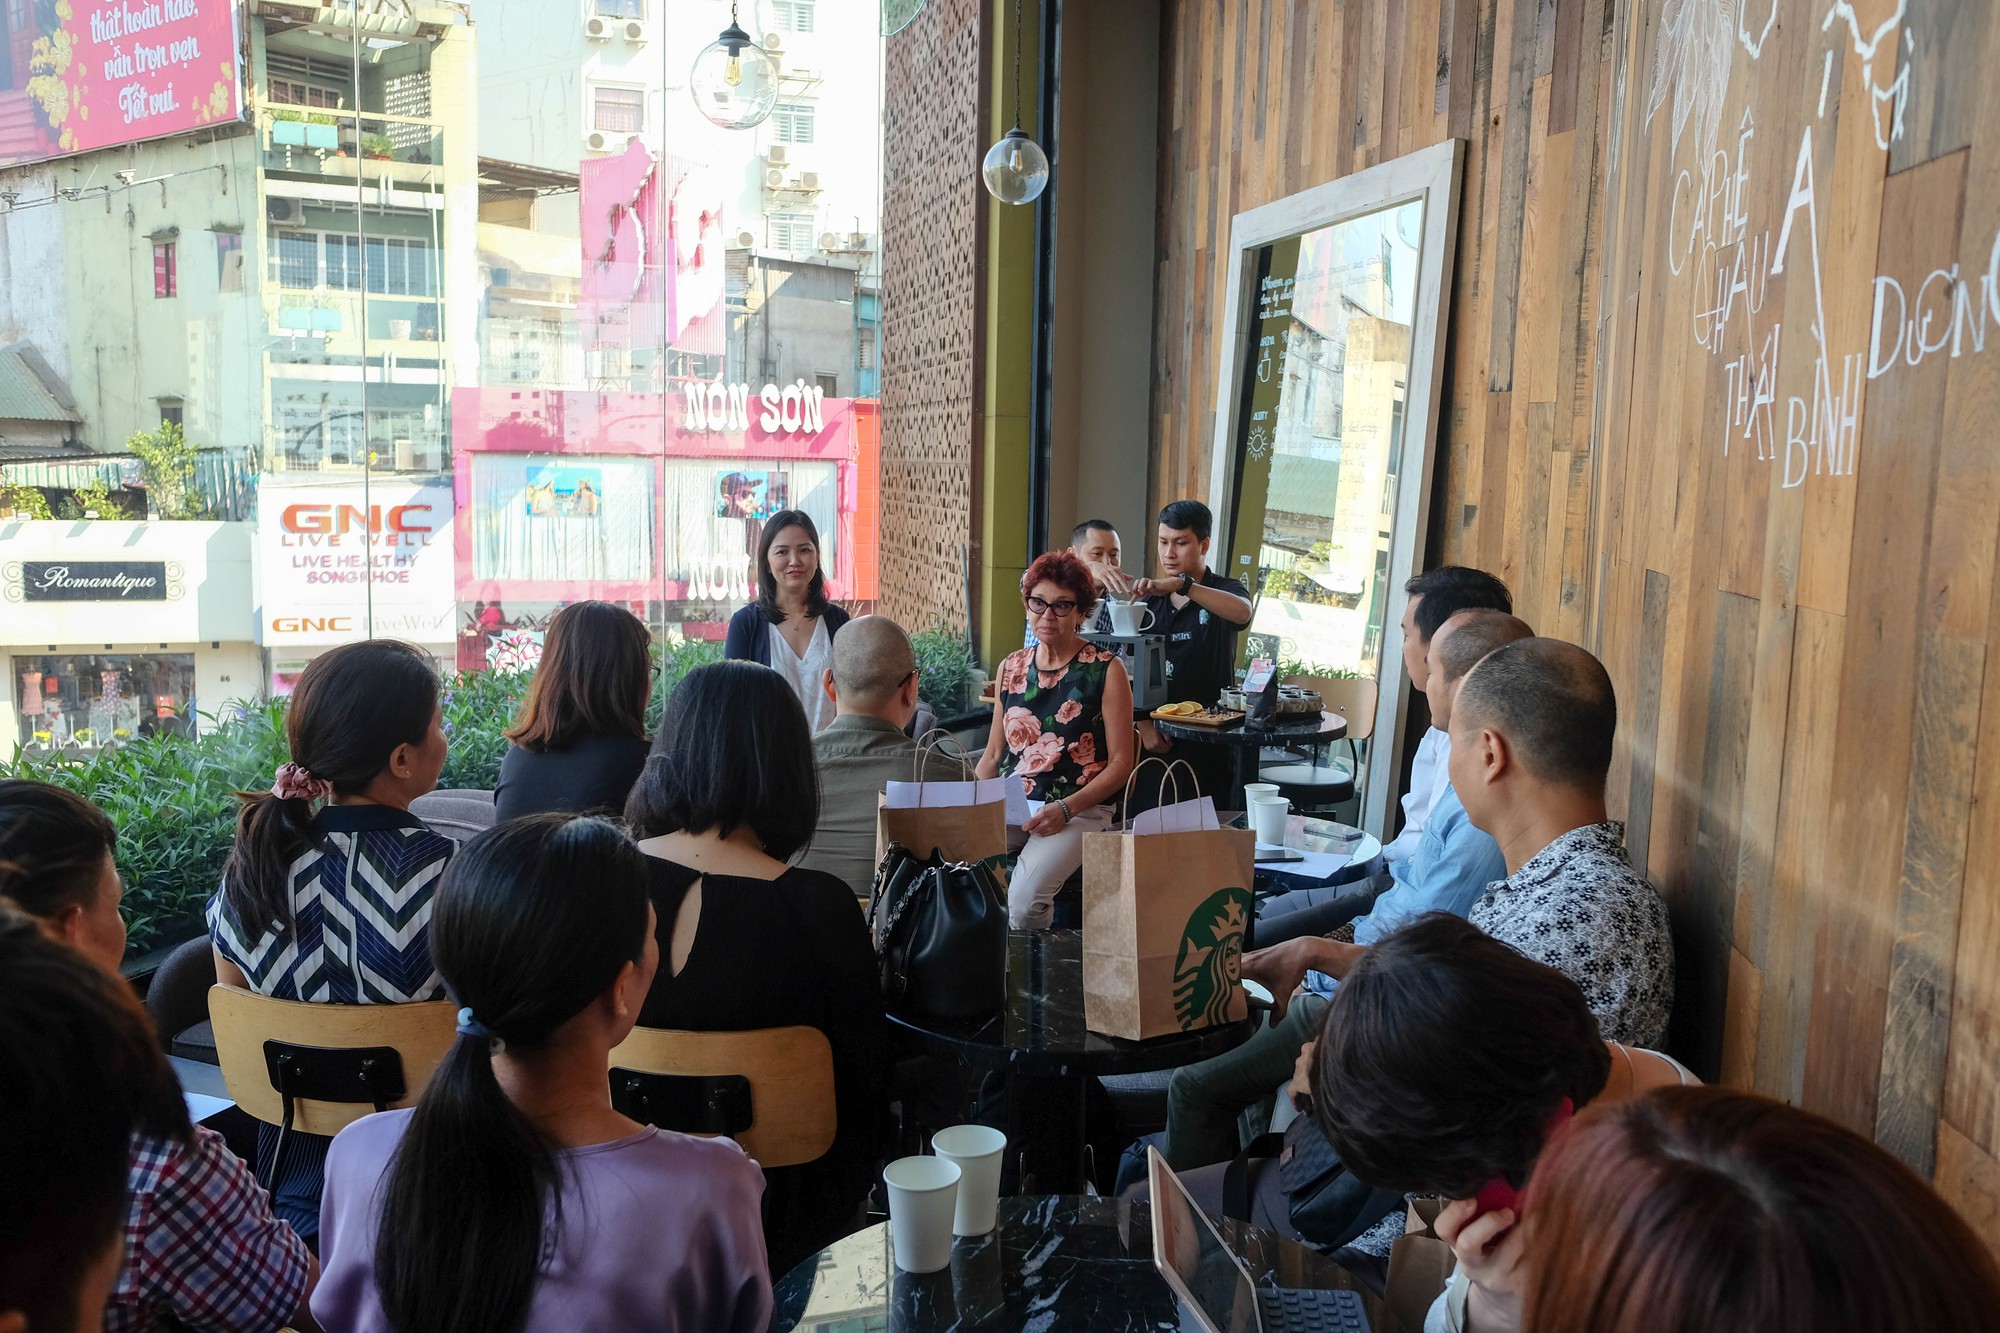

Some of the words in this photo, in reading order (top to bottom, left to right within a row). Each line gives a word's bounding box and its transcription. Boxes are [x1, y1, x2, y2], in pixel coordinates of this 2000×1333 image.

[90, 7, 122, 45] thật
[123, 1, 163, 35] hoàn
[104, 45, 134, 81] vẫn
[134, 42, 169, 77] trọn
[170, 36, 201, 69] vẹn
[149, 82, 180, 116] vui.
[684, 371, 750, 432] NÓN
[760, 378, 824, 433] SƠN
[281, 504, 432, 533] GNC
[282, 534, 341, 547] LIVE
[360, 533, 432, 547] WELL
[293, 555, 332, 568] LIVE
[34, 565, 157, 597] Romantique
[272, 617, 352, 633] GNC
